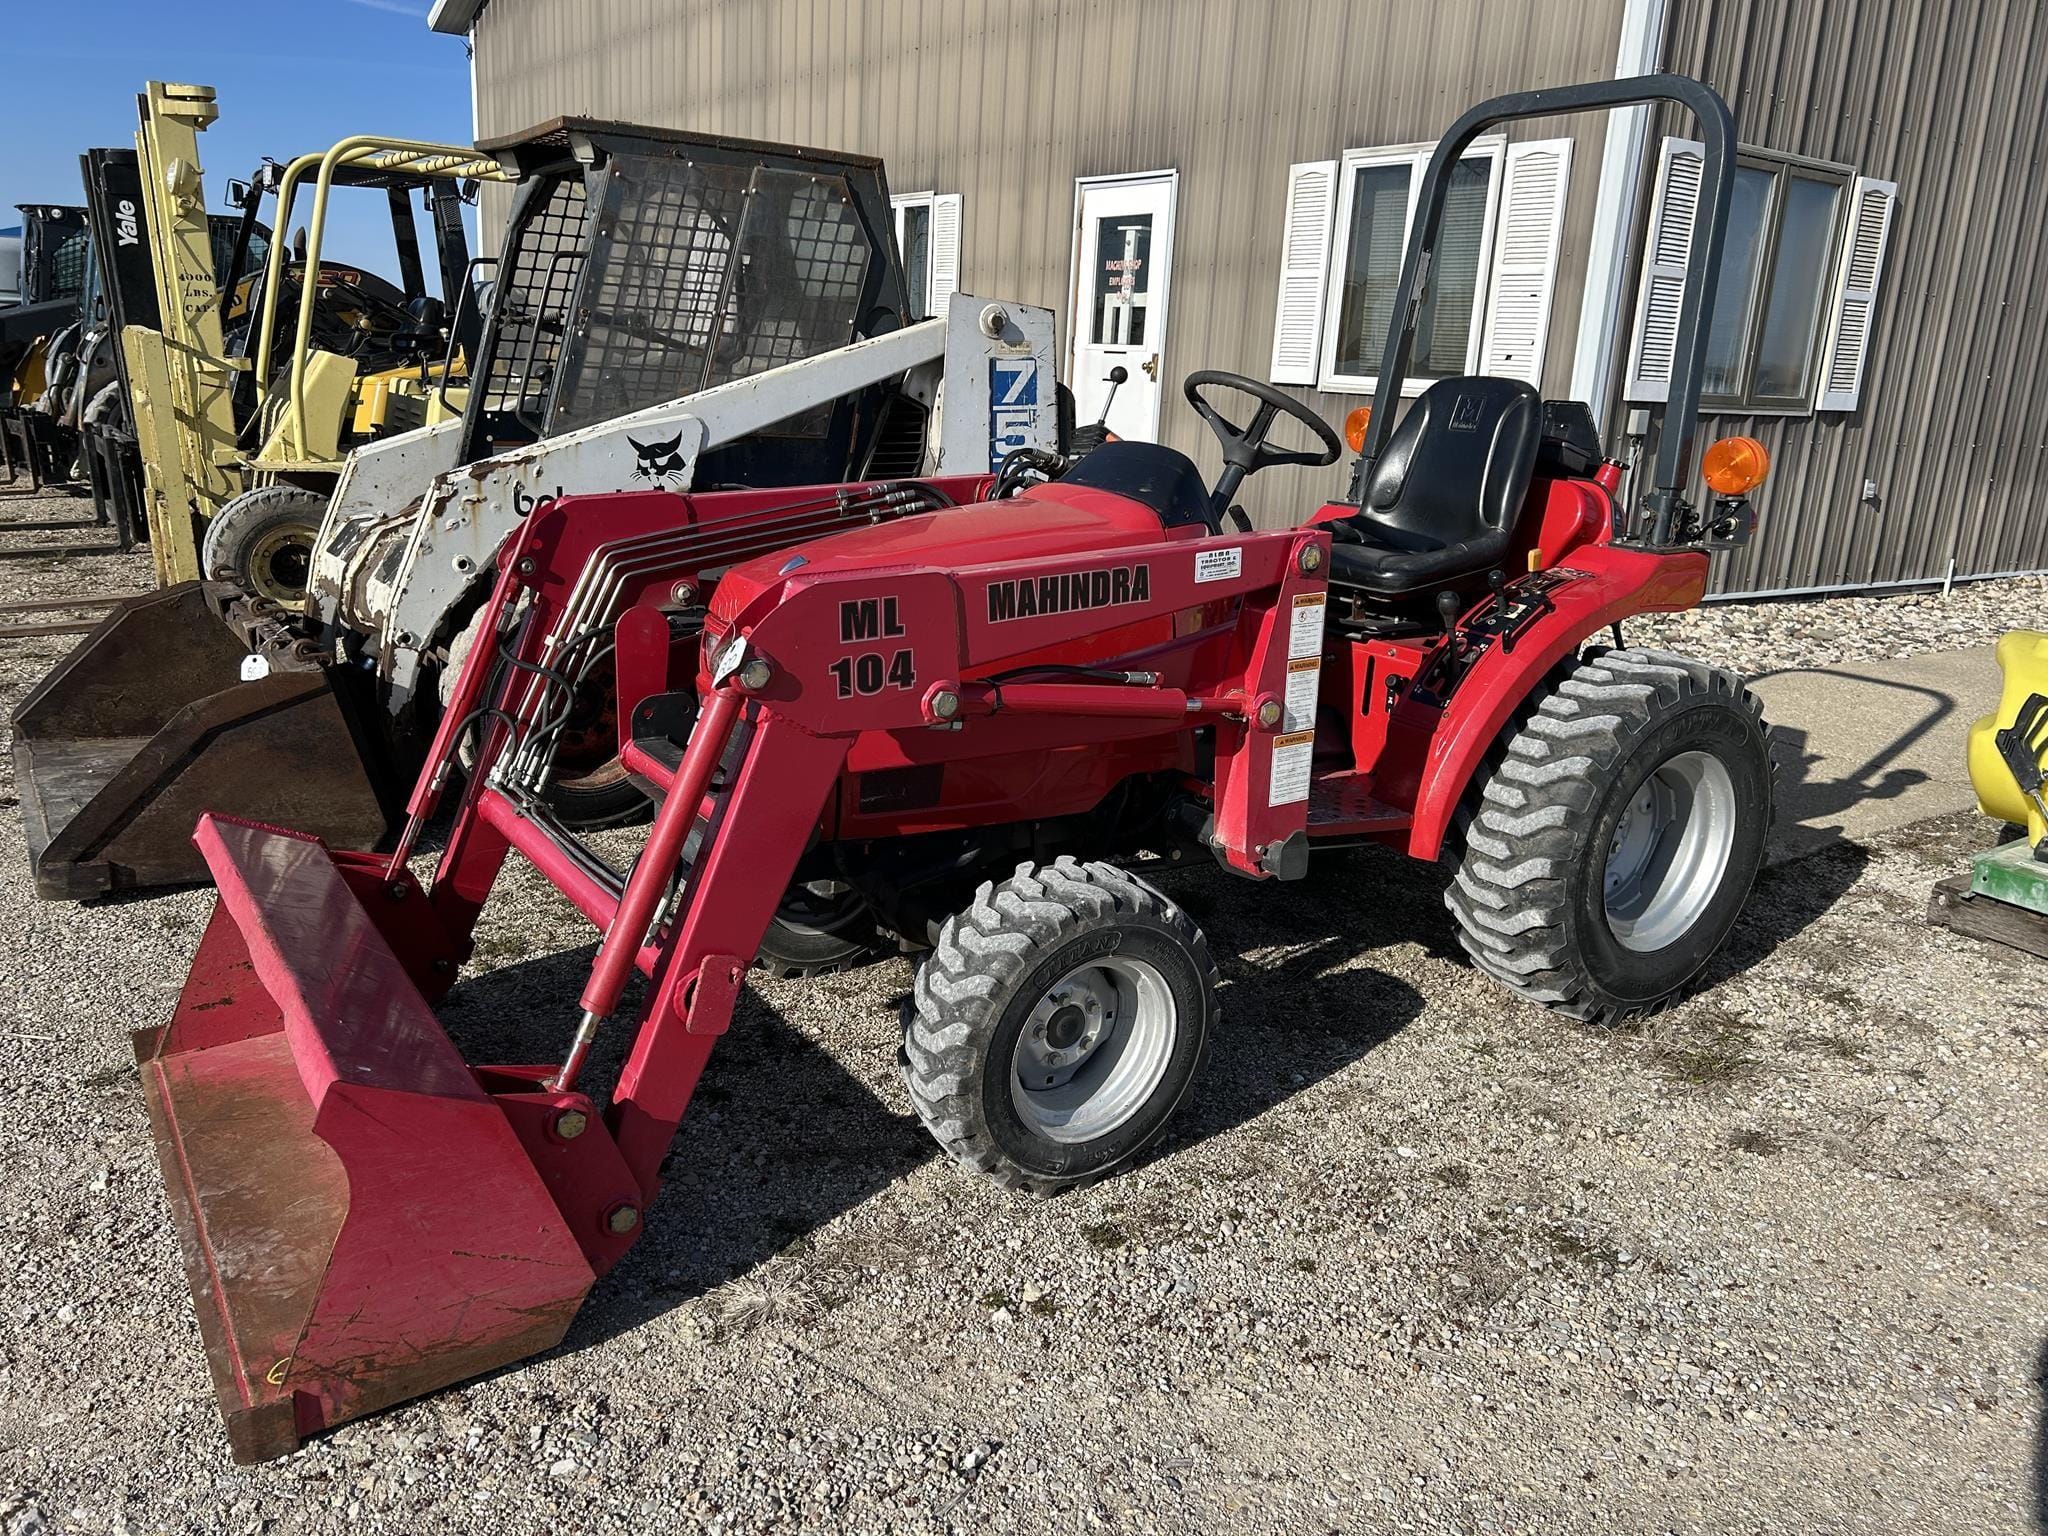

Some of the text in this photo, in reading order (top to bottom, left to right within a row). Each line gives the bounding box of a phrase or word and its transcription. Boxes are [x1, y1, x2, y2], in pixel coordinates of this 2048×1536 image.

[115, 200, 138, 246] Yale
[178, 273, 212, 282] 4000
[185, 289, 213, 298] LBS.
[185, 304, 215, 313] CAP.
[994, 360, 1037, 478] 75
[987, 564, 1150, 624] MAHINDRA
[839, 595, 905, 644] ML
[828, 648, 917, 699] 104
[1042, 934, 1112, 980] TITAN
